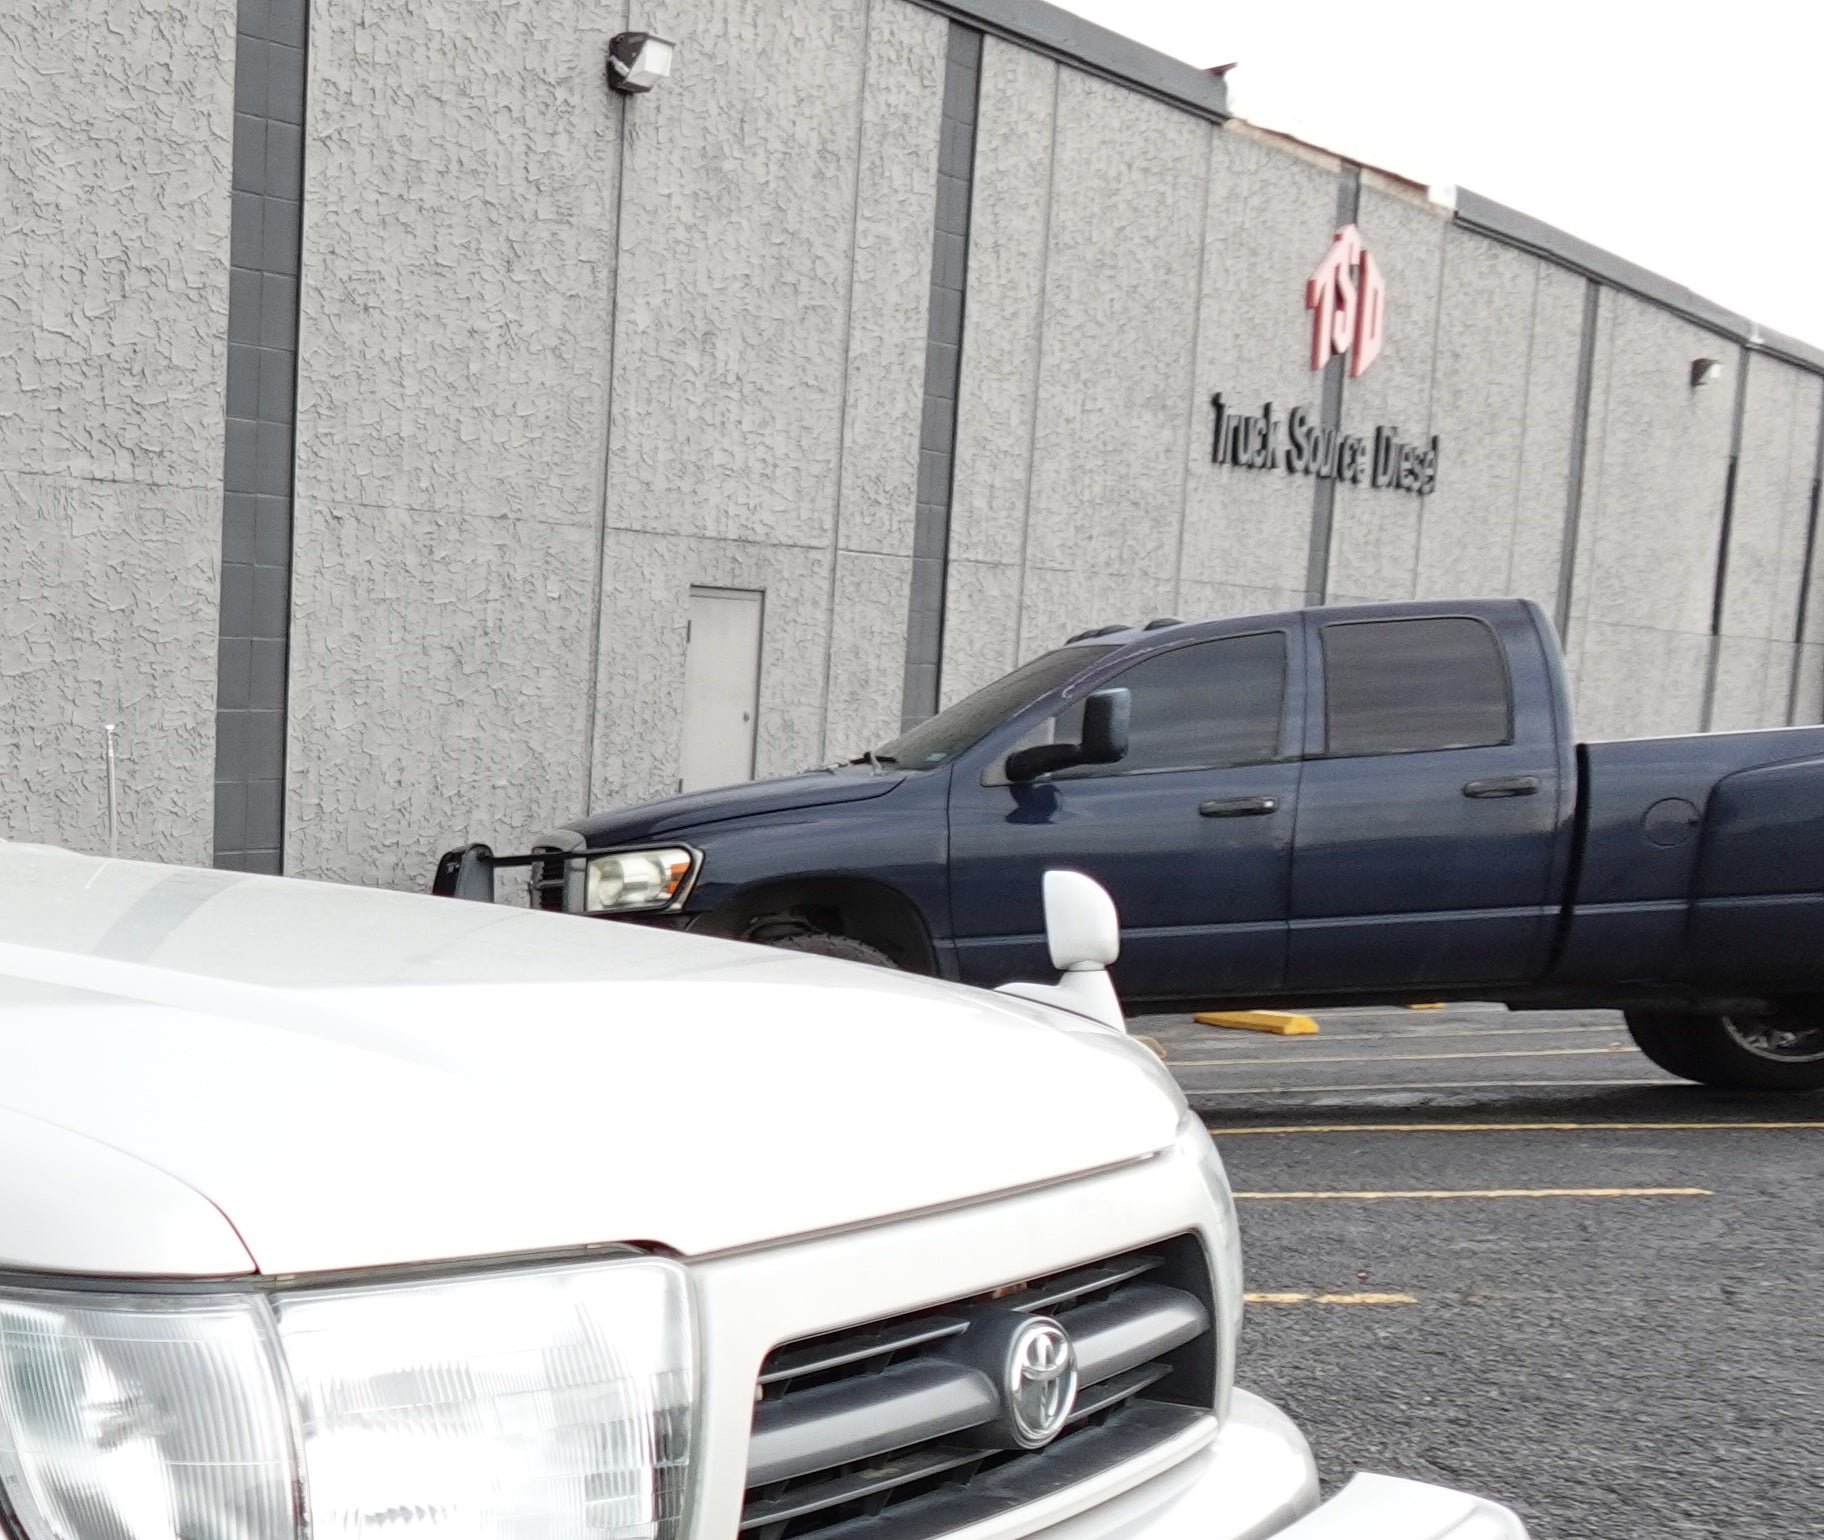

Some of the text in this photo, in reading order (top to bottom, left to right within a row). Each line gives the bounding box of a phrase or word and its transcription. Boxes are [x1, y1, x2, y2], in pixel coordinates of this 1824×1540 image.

[1305, 223, 1385, 378] TSD
[1211, 391, 1440, 496] Truck Source Diesel
